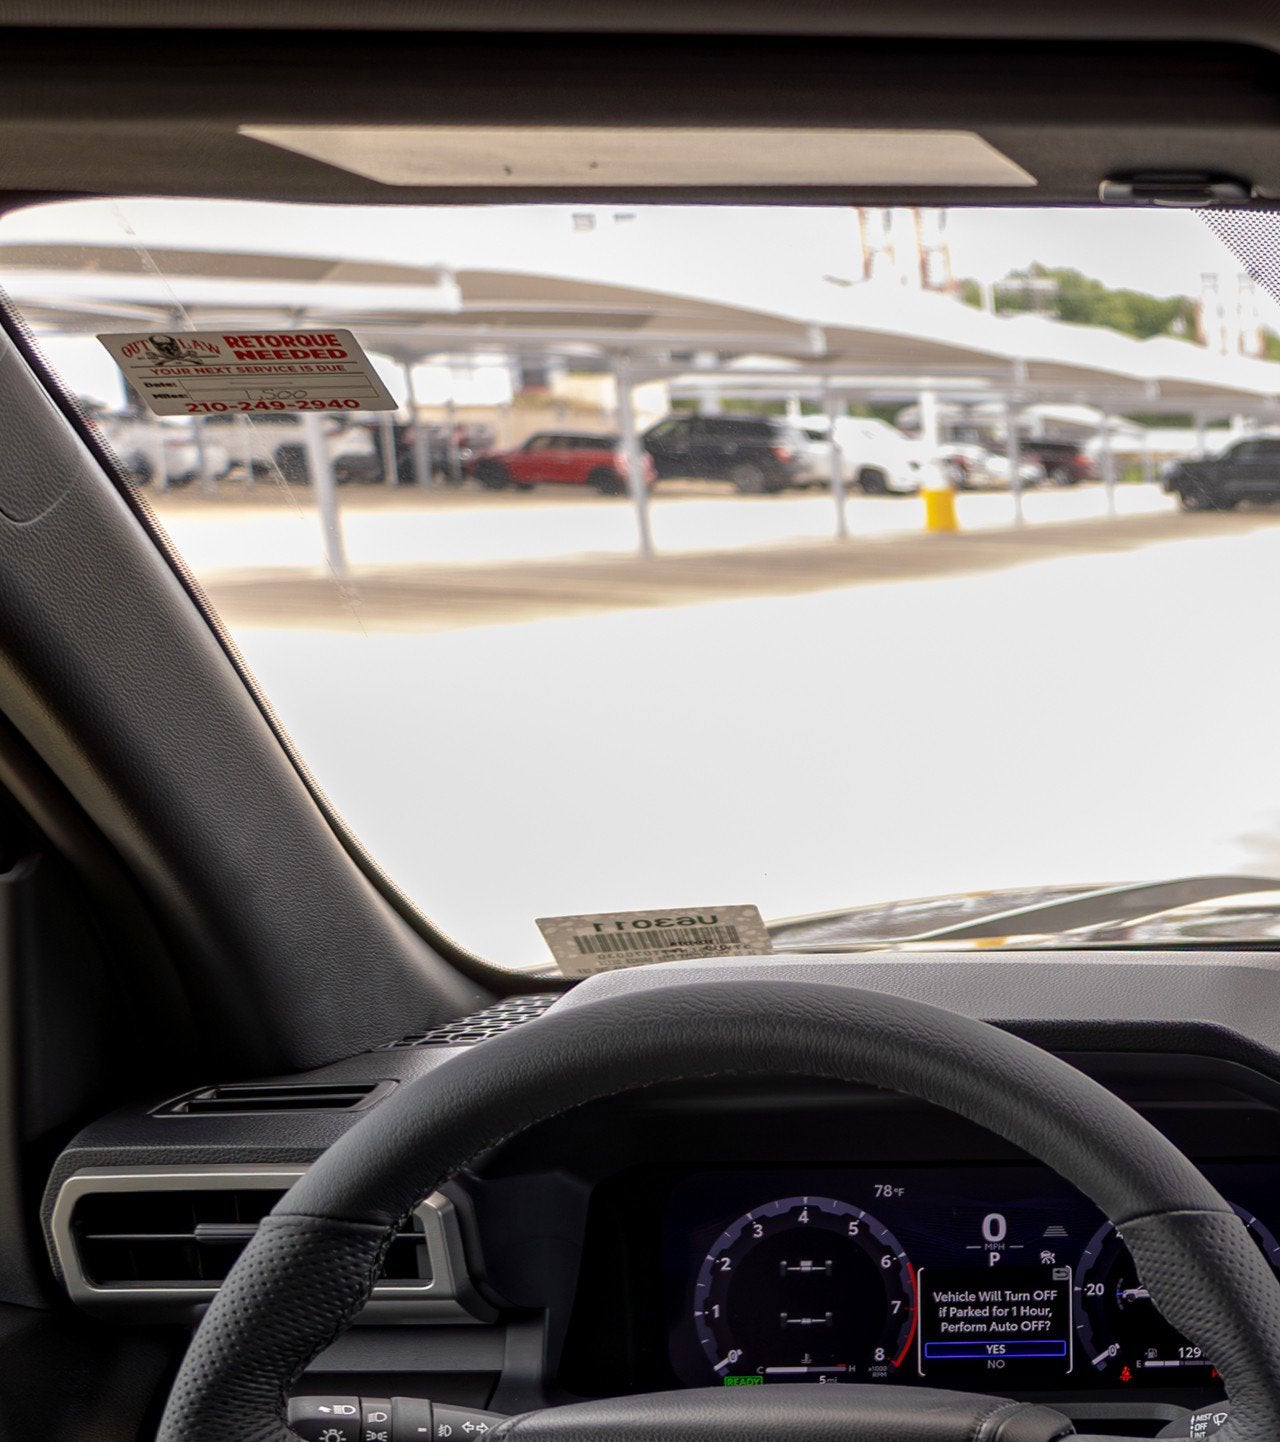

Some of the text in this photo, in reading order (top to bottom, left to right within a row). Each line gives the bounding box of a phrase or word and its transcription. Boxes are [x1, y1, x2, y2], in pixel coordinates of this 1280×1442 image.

[223, 334, 341, 348] RETORQUE
[234, 350, 348, 360] NEEDED
[151, 367, 190, 376] YOUR
[194, 366, 232, 374] NEXT
[236, 366, 296, 374] SERVICE
[152, 392, 188, 400] Miles:
[185, 400, 360, 412] 210-249-2940
[798, 1212, 809, 1224] 4
[753, 1224, 763, 1238] 3
[848, 1223, 859, 1236] 5
[982, 1213, 1007, 1241] 0
[720, 1258, 731, 1271] 2
[881, 1256, 891, 1268] 6
[989, 1252, 1000, 1266] P
[1086, 1283, 1105, 1296] 20
[933, 1290, 1058, 1302] Vehicle Will Turn OFF
[712, 1305, 720, 1319] 1
[891, 1301, 901, 1314] 7
[939, 1307, 1052, 1318] if Parked for 1 Hour,
[941, 1321, 1051, 1332] Perform Auto OFF?
[875, 1348, 885, 1361] 8
[986, 1344, 1006, 1354] YES
[987, 1360, 1005, 1369] NO
